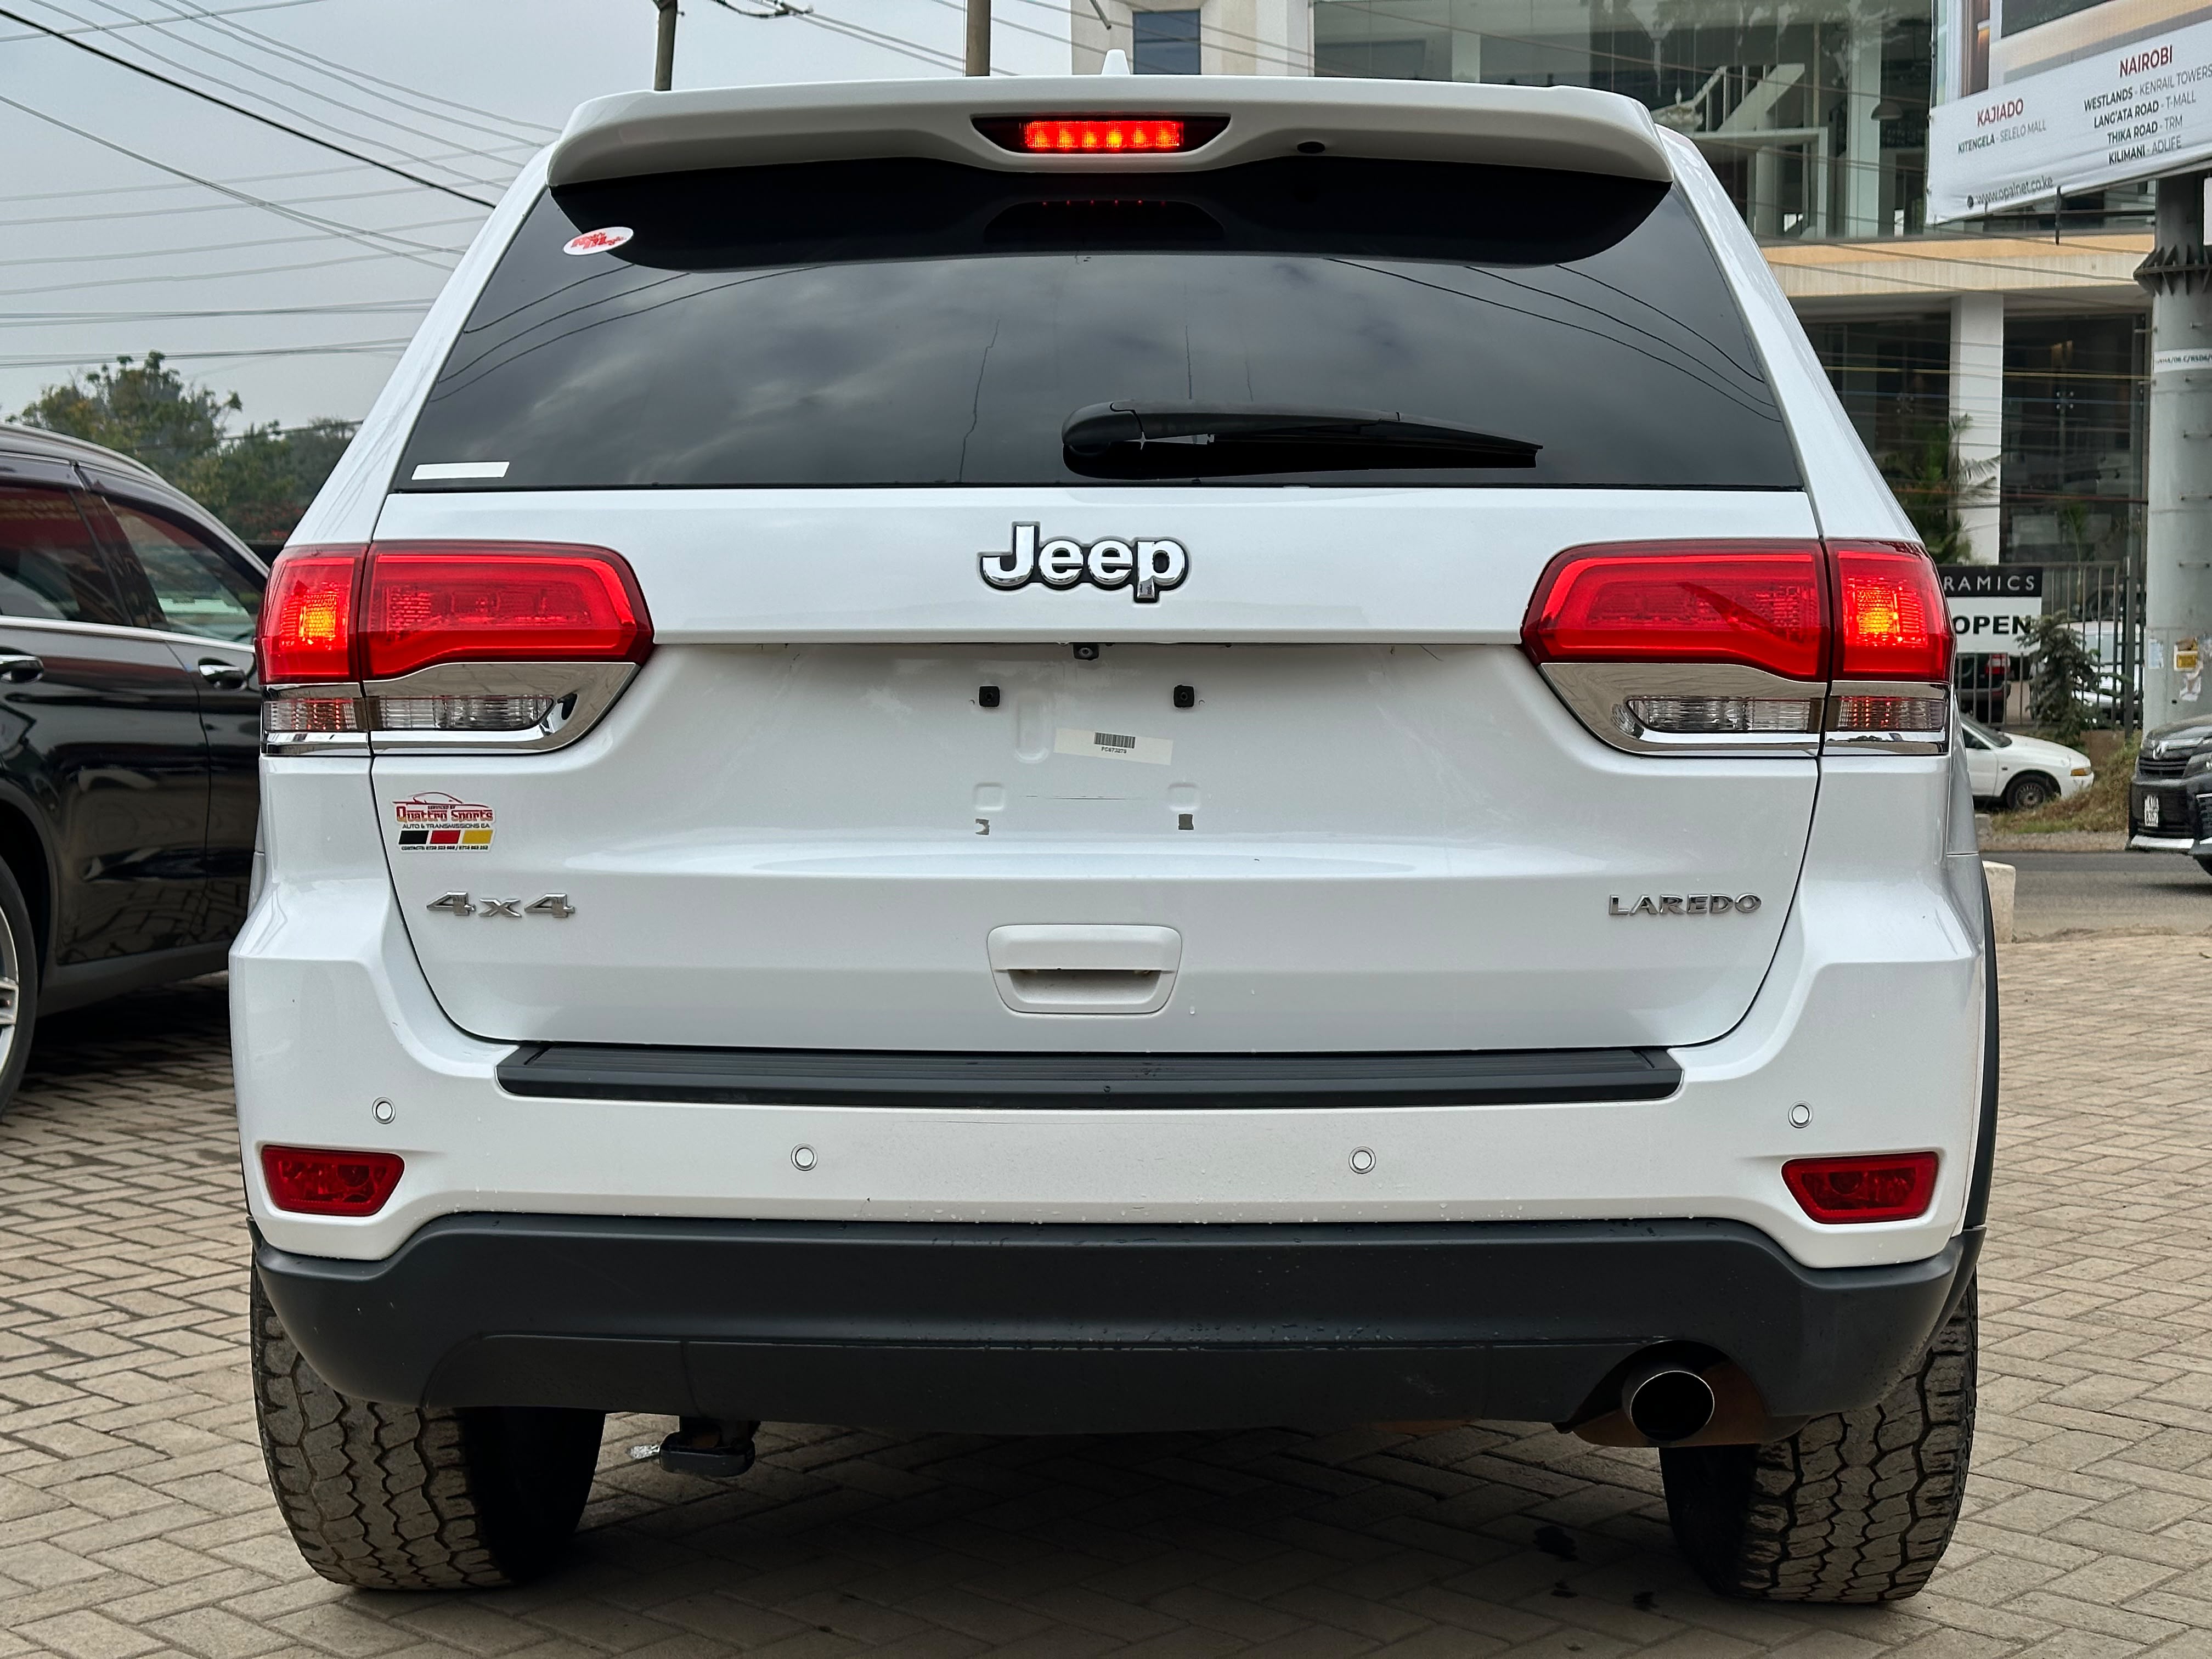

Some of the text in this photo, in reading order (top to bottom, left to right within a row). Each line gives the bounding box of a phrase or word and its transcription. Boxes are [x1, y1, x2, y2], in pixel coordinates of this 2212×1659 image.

[2120, 44, 2172, 77] NAIROBI
[2084, 86, 2133, 111] WESTLANDS
[2140, 76, 2174, 97] KENRAIL
[2176, 64, 2212, 86] TOWERS
[1977, 98, 2023, 127] KAJIADO
[2094, 108, 2133, 128] LANG'ATA
[2135, 101, 2159, 117] ROAD
[2166, 91, 2196, 110] T-MALL
[1958, 133, 1995, 155] KITENGELA
[2000, 124, 2025, 143] SELELO
[2028, 119, 2046, 133] MALL
[2107, 128, 2131, 145] THIKA
[2134, 121, 2158, 138] ROAD
[2164, 114, 2182, 131] TRM
[2109, 145, 2145, 165] KILIMANI
[2152, 135, 2182, 154] ADLIFE
[1976, 176, 2053, 205] www.opalnet.co.ke
[980, 523, 1188, 603] Jeep
[1944, 575, 2034, 591] RAMICS
[1953, 615, 2032, 635] OPEN
[396, 806, 493, 823] Quattro Sports
[426, 891, 575, 918] 4x4
[1609, 893, 1762, 916] LAREDO
